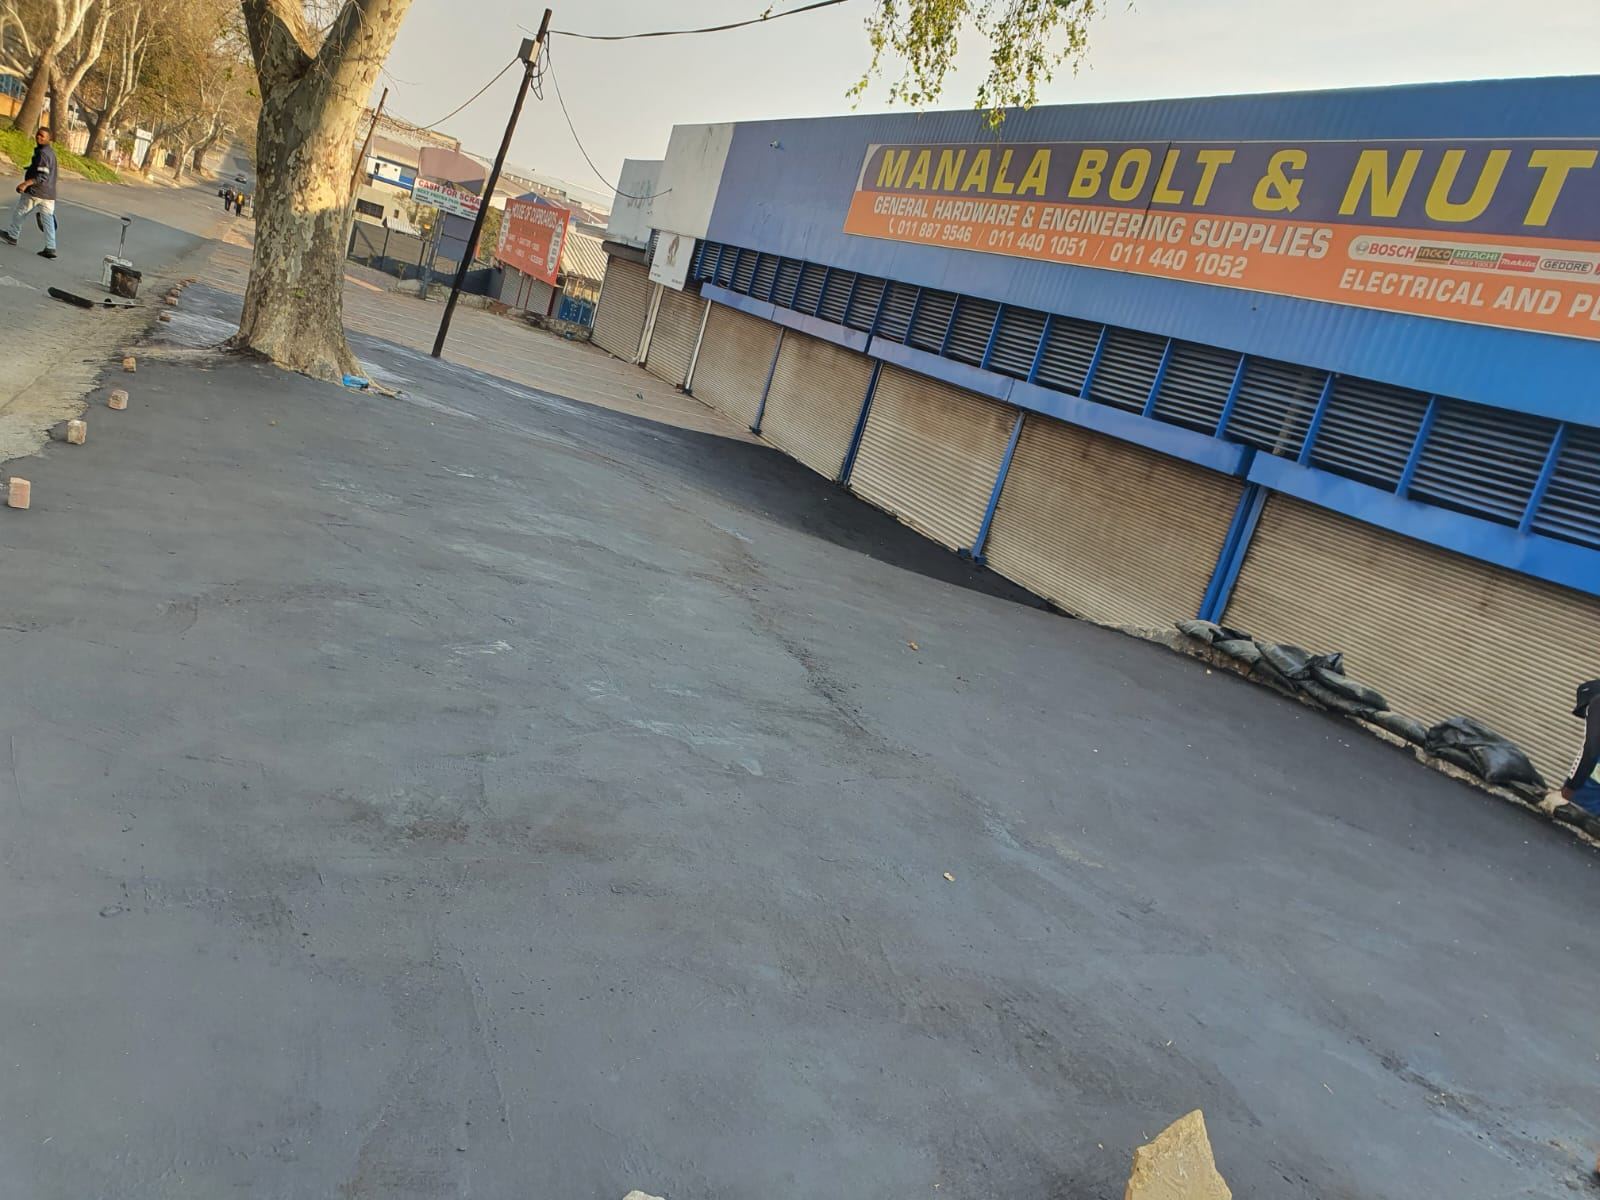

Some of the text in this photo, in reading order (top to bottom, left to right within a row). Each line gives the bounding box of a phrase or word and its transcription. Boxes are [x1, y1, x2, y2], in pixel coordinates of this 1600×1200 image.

[418, 180, 440, 192] CASH
[441, 187, 458, 198] FOR
[876, 148, 1598, 226] MANALA BOLT & NUT
[874, 196, 1334, 260] GENERAL HARDWARE & ENGINEERING SUPPLIES
[897, 219, 916, 237] 011
[918, 222, 942, 239] 887
[941, 224, 972, 242] 9546
[988, 229, 1018, 248] 011
[1016, 232, 1046, 252] 440
[1050, 235, 1088, 257] 1051
[1109, 242, 1144, 265] 011
[1148, 246, 1187, 271] 440
[1195, 252, 1248, 279] 1052
[1368, 243, 1417, 259] BOSCH
[1455, 250, 1498, 261] HITACHI
[1543, 260, 1590, 272] GEDORE
[1339, 268, 1485, 306] ELECTRICAL
[1492, 285, 1562, 315] AND
